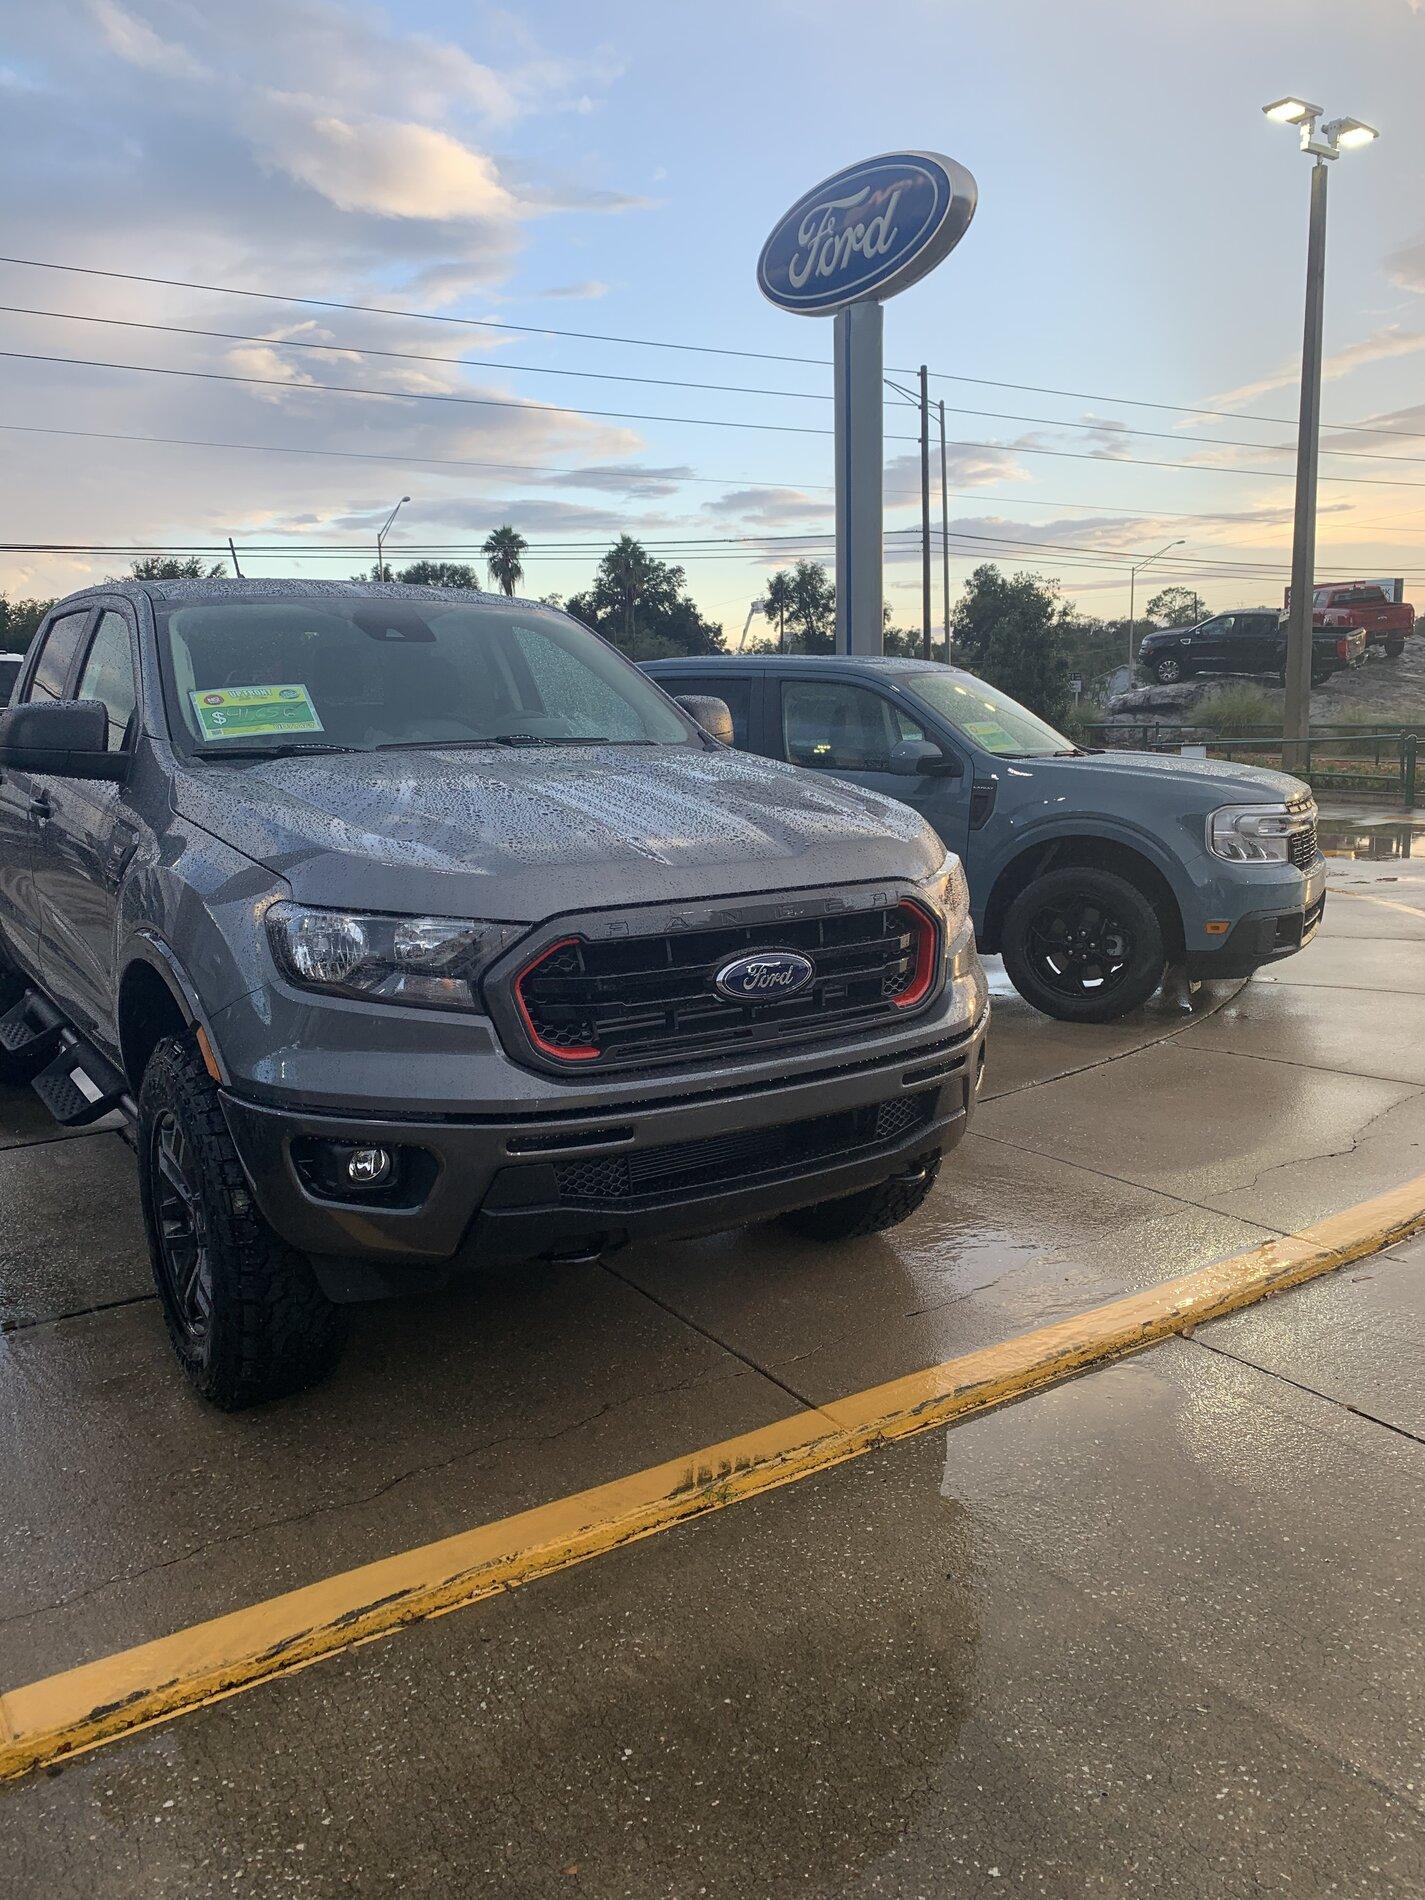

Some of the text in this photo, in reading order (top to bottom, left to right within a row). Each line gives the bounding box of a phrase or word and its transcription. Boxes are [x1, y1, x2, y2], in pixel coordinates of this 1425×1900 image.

[788, 185, 901, 289] Ford
[604, 892, 888, 936] RANGER
[743, 961, 794, 990] Ford
